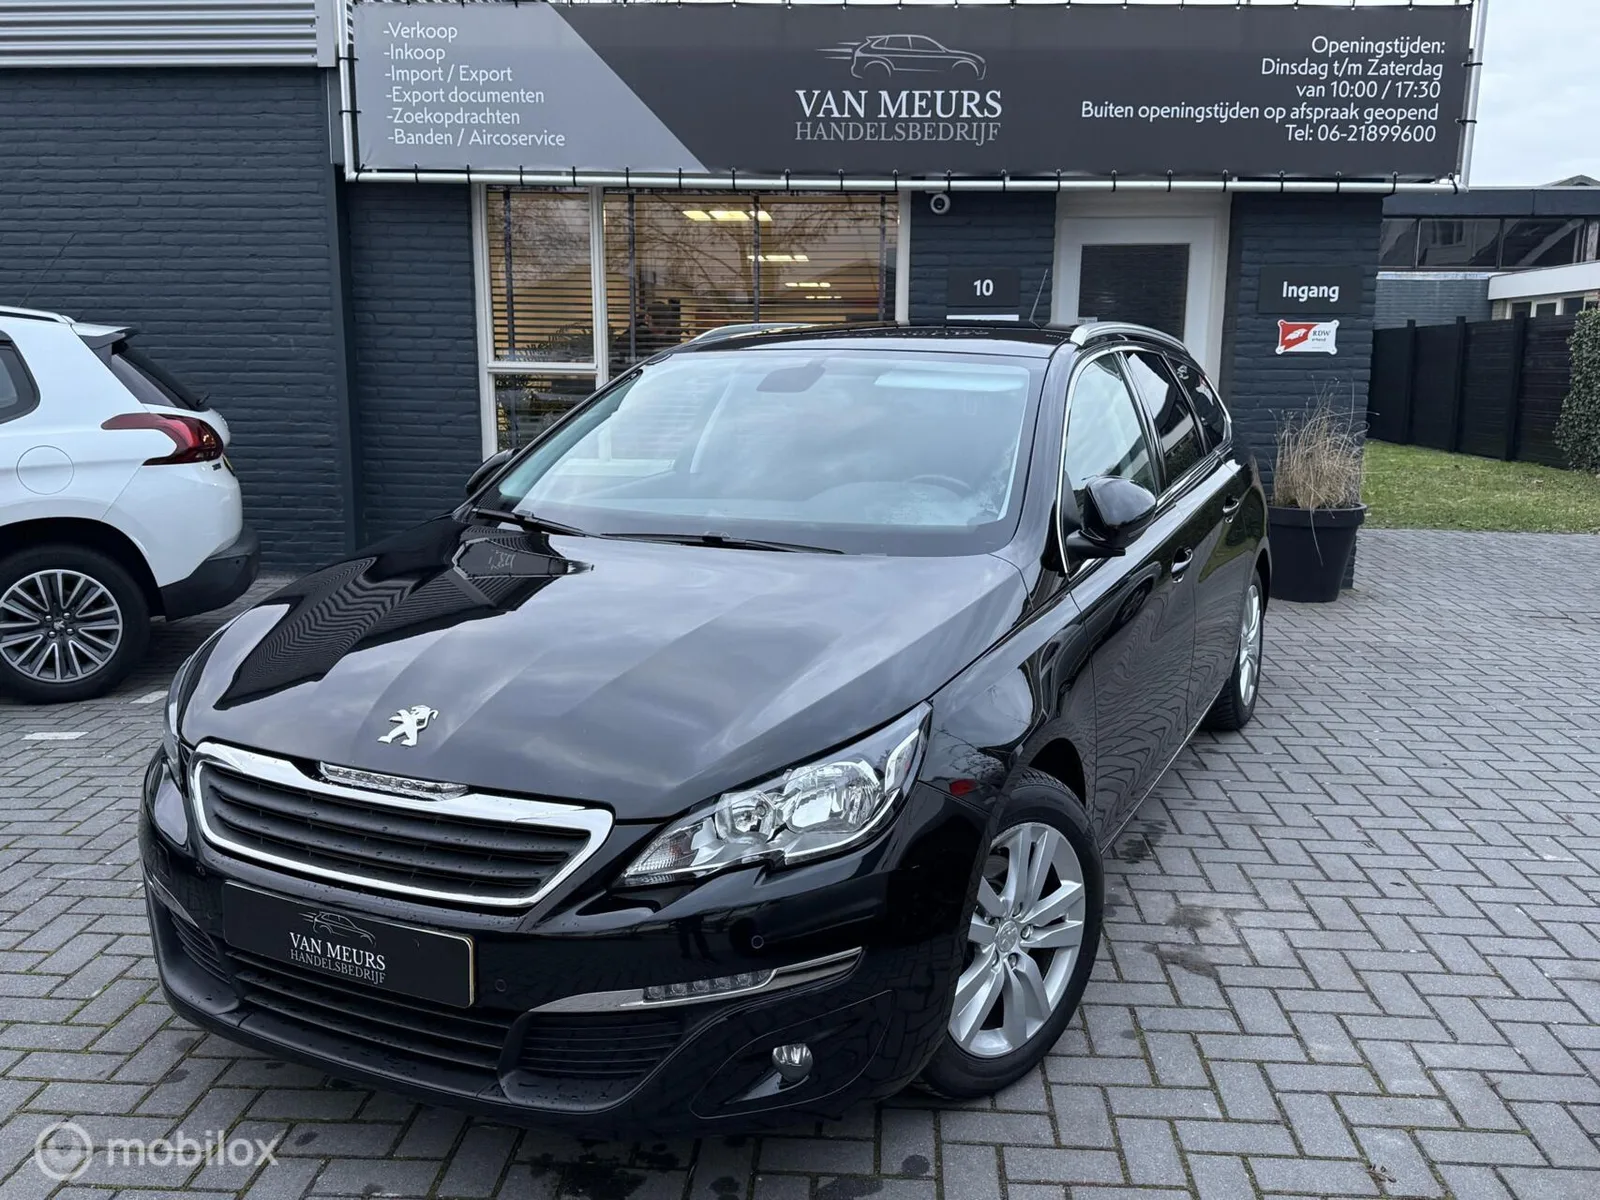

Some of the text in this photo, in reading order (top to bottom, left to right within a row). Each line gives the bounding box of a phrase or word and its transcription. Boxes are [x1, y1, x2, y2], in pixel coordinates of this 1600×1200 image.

[383, 22, 458, 42] -Verkoop
[384, 44, 446, 64] -Inkoop
[1311, 36, 1446, 57] Openingstijden:
[385, 64, 513, 85] -Import / Export
[1261, 58, 1444, 80] Dinsdag t/m Zaterdag
[386, 87, 545, 106] -Export documenten
[1296, 80, 1441, 100] van 10:00 / 17:30
[795, 90, 1002, 118] VAN MEURS
[1081, 101, 1440, 124] Buiten openingstijden op afspraak geopend
[387, 107, 520, 127] -Zoekopdrachten
[388, 128, 566, 147] -Banden / Aircoservice
[795, 121, 1001, 146] HANDELSBEDRIJF
[1286, 124, 1437, 143] Tel: 06-21899600
[973, 279, 994, 297] 10
[1282, 281, 1340, 303] Ingang
[289, 932, 386, 971] VAN MEURS
[289, 948, 386, 985] HANDELSBEDRIJF
